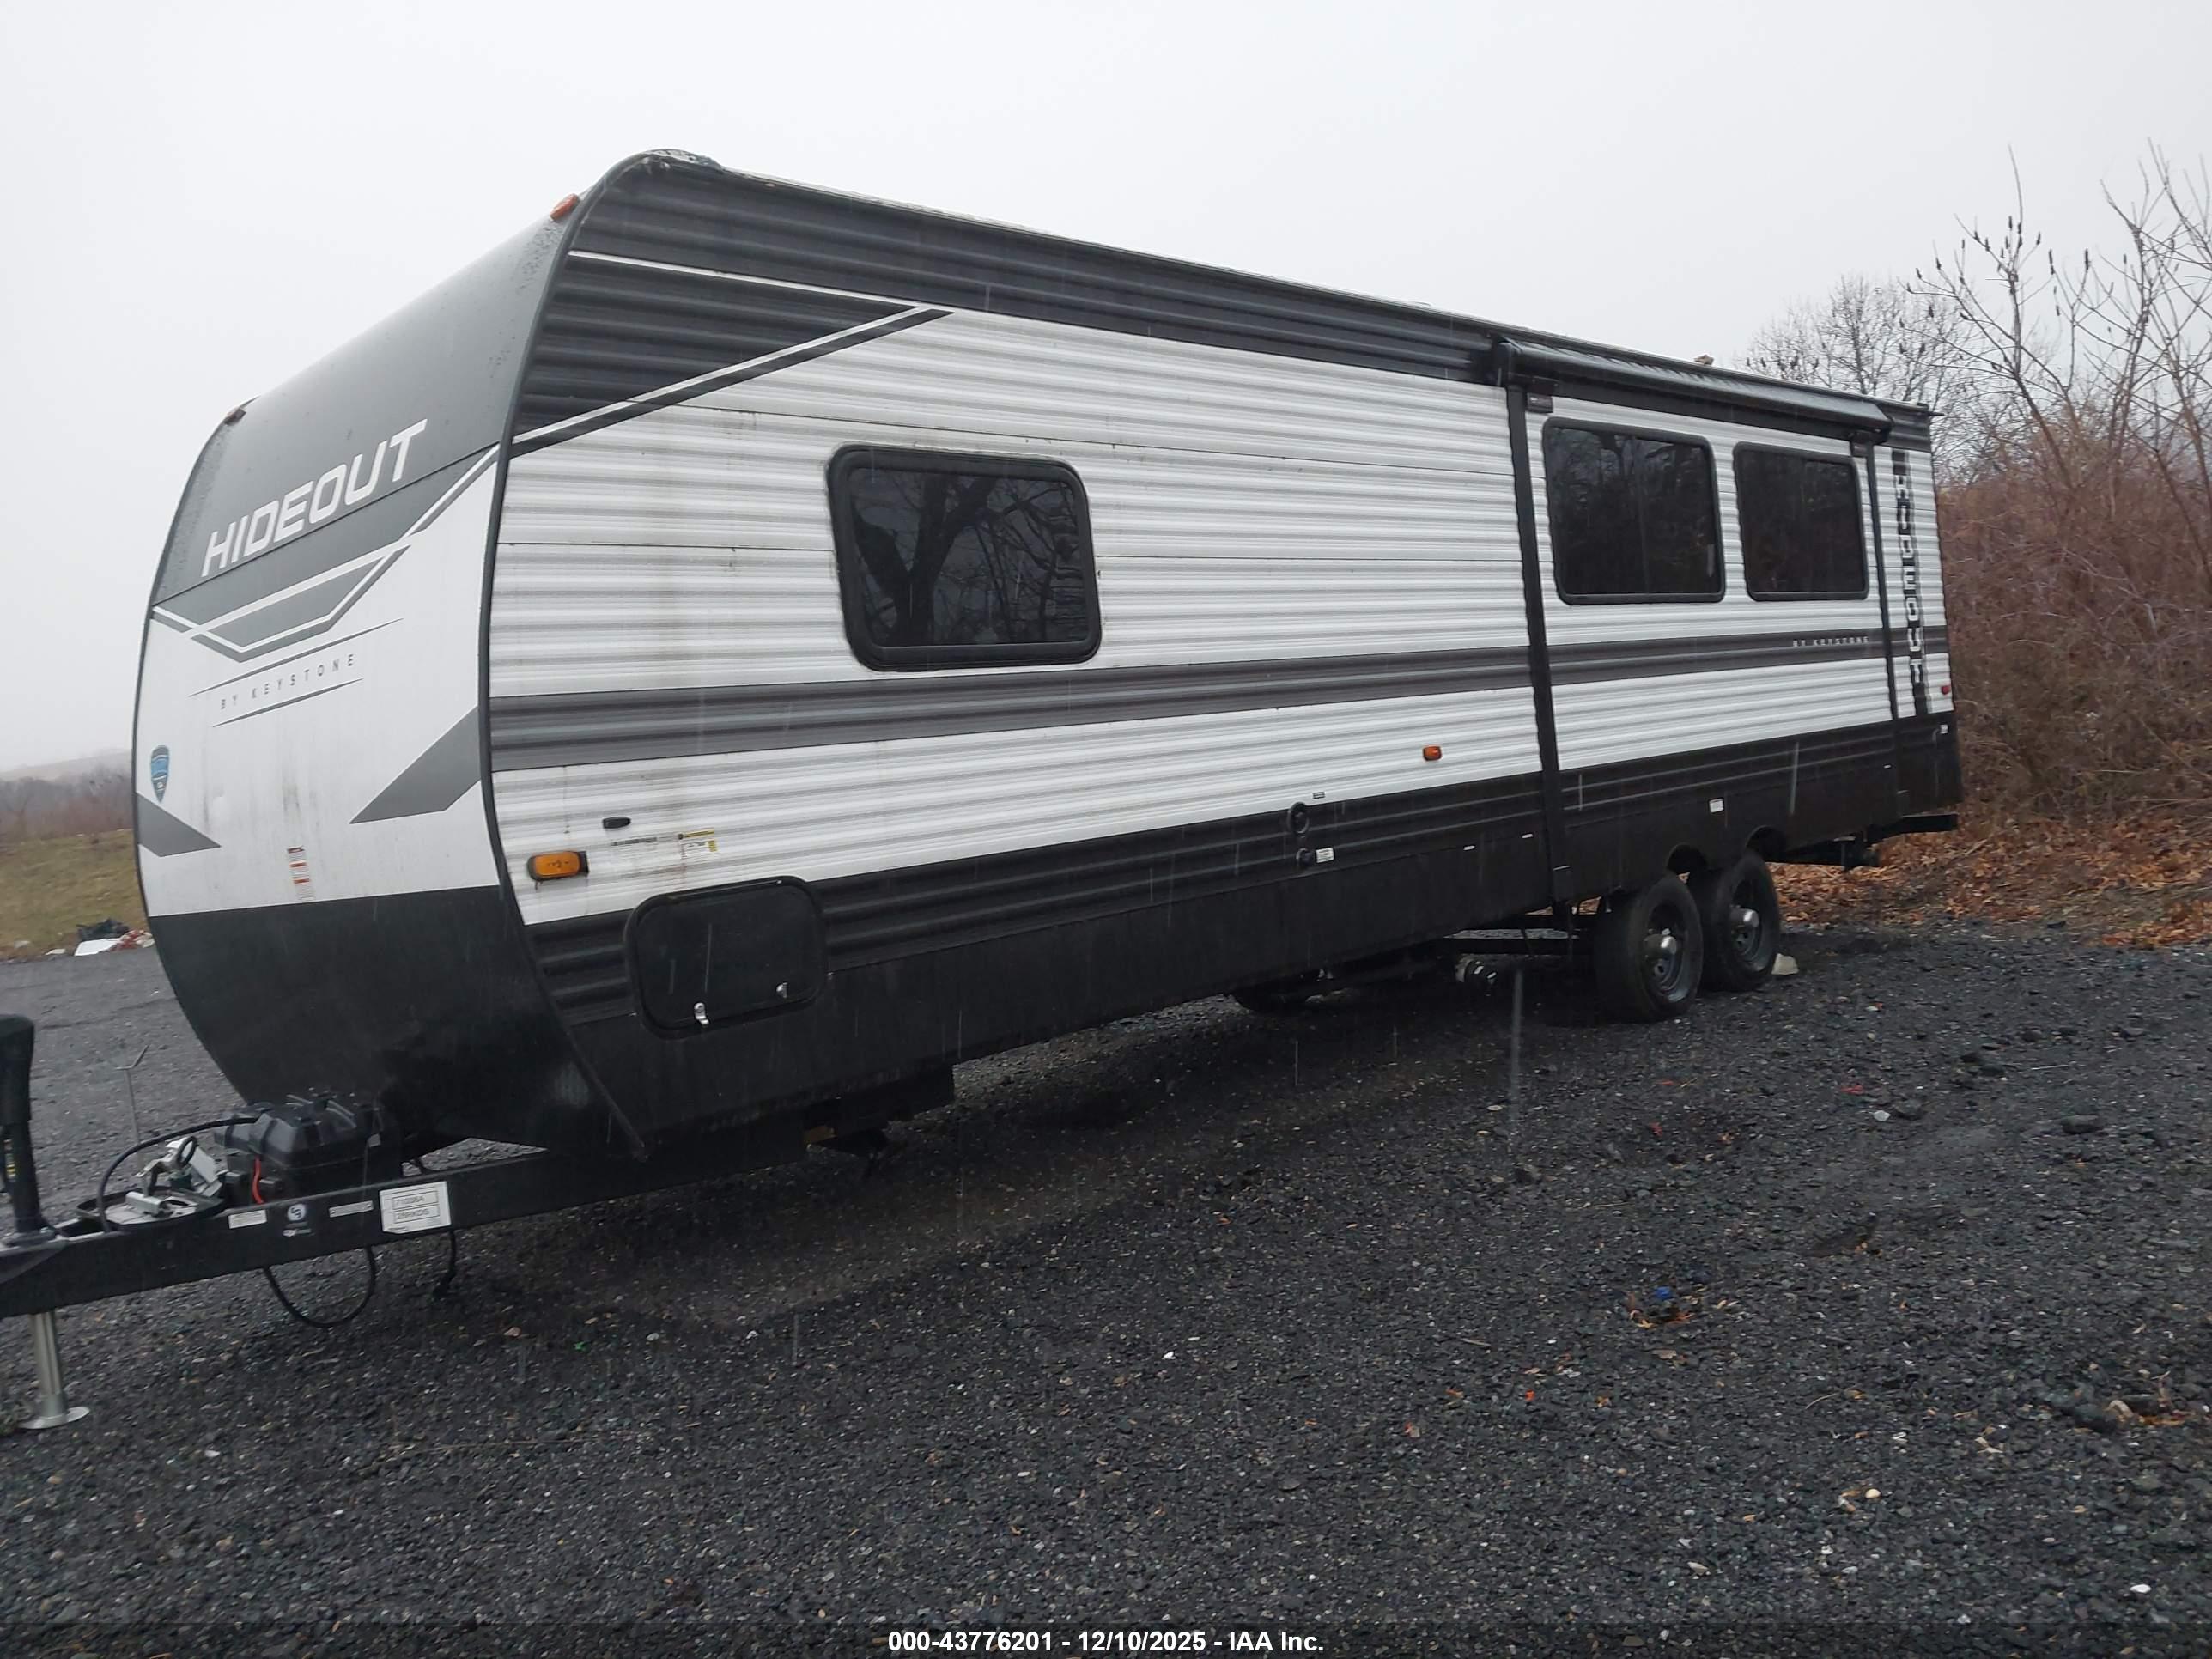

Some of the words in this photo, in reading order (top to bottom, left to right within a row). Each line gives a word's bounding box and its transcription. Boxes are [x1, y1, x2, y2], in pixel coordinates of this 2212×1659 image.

[201, 419, 428, 577] HIDEOUT
[1894, 474, 1923, 684] HIDEOUT
[221, 694, 238, 710] BY
[252, 653, 355, 699] KEYSTONE
